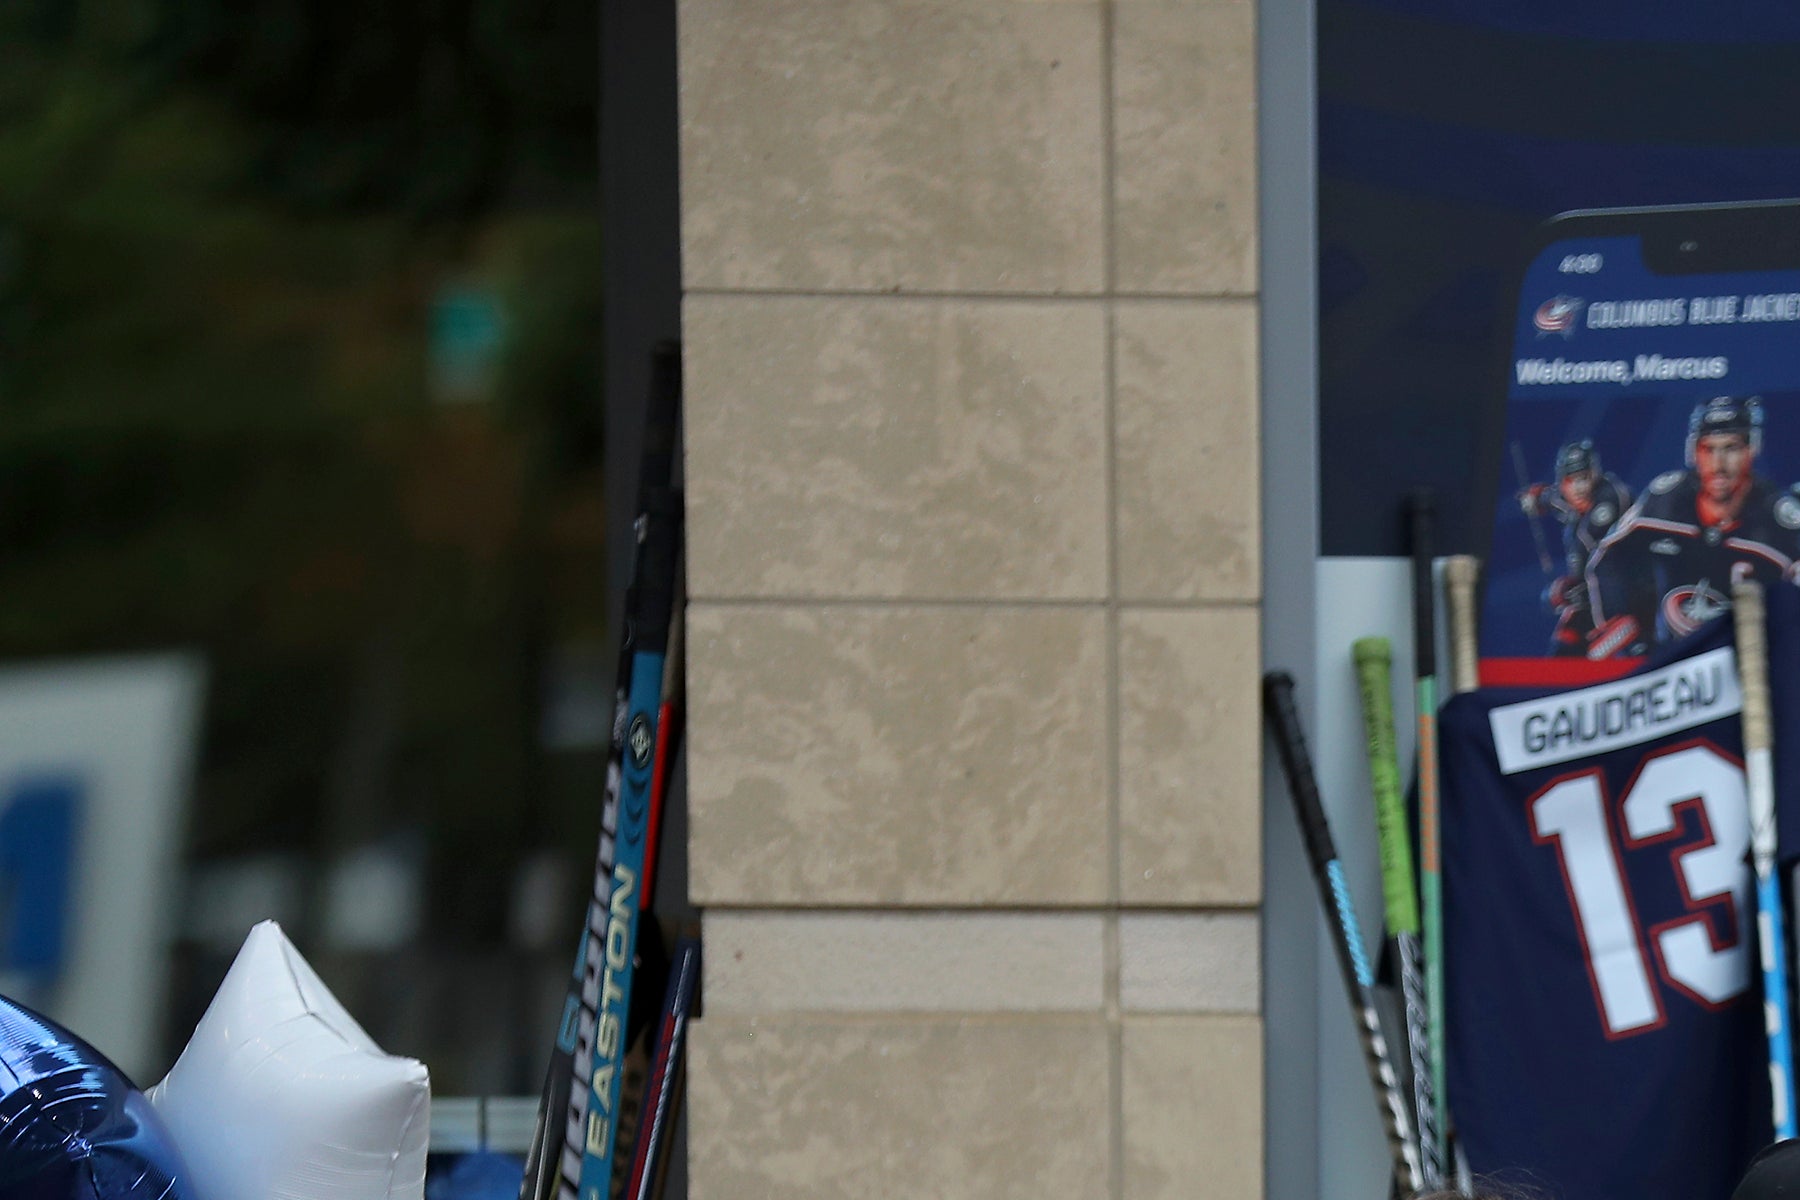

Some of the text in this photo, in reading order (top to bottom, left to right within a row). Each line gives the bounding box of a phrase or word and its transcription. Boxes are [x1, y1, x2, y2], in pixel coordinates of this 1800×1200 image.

[1587, 298, 1687, 329] COLUMBUS
[1688, 295, 1740, 325] BLUE
[1515, 354, 1728, 386] Welcome, Marcus
[1522, 664, 1722, 755] GAUDREAU
[1525, 736, 1754, 1042] 13
[586, 863, 637, 1160] EASTON
